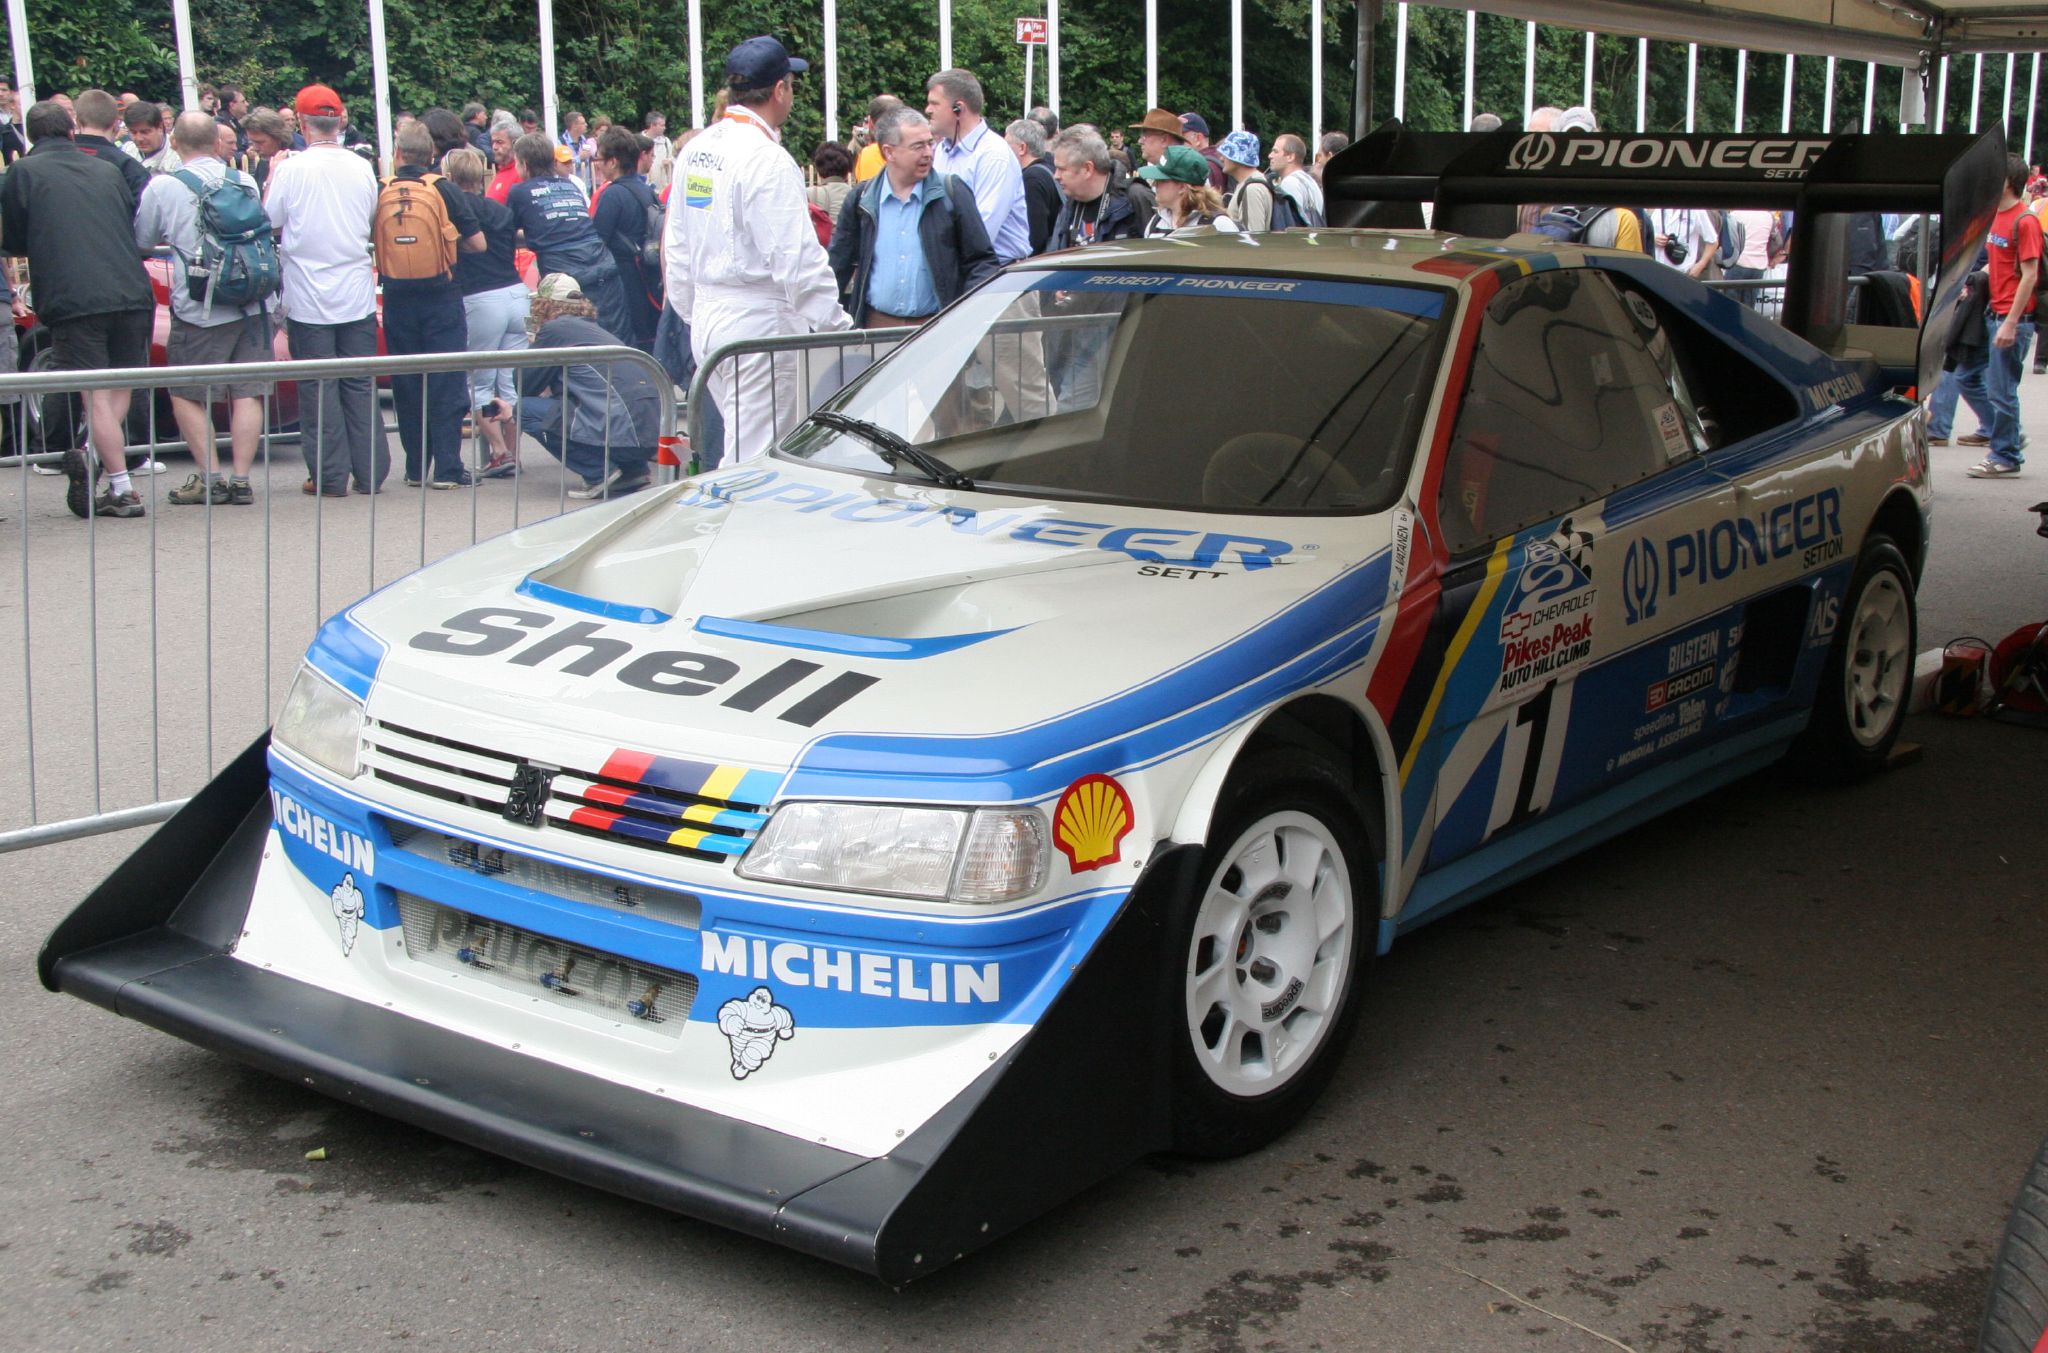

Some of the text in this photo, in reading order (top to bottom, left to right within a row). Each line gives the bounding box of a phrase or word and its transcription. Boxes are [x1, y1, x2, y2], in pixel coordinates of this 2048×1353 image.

[1084, 275, 1298, 292] PEUGEOT PIONEER
[1807, 371, 1866, 411] MICHELIN
[740, 482, 1293, 570] PIONEER
[1666, 487, 1842, 596] PIONEER
[1803, 536, 1843, 570] SETTON
[1533, 589, 1597, 626] CHEVROLET
[409, 607, 882, 727] Shell
[1500, 666, 1532, 693] AUTO
[1532, 657, 1556, 680] HILL
[1556, 639, 1591, 668] CLIMB
[1668, 629, 1720, 674] BILSTEIN
[1487, 678, 1558, 840] 1
[1617, 741, 1656, 768] MONDIAL
[701, 931, 1000, 1004] MICHELIN
[1263, 979, 1303, 1018] speedline
